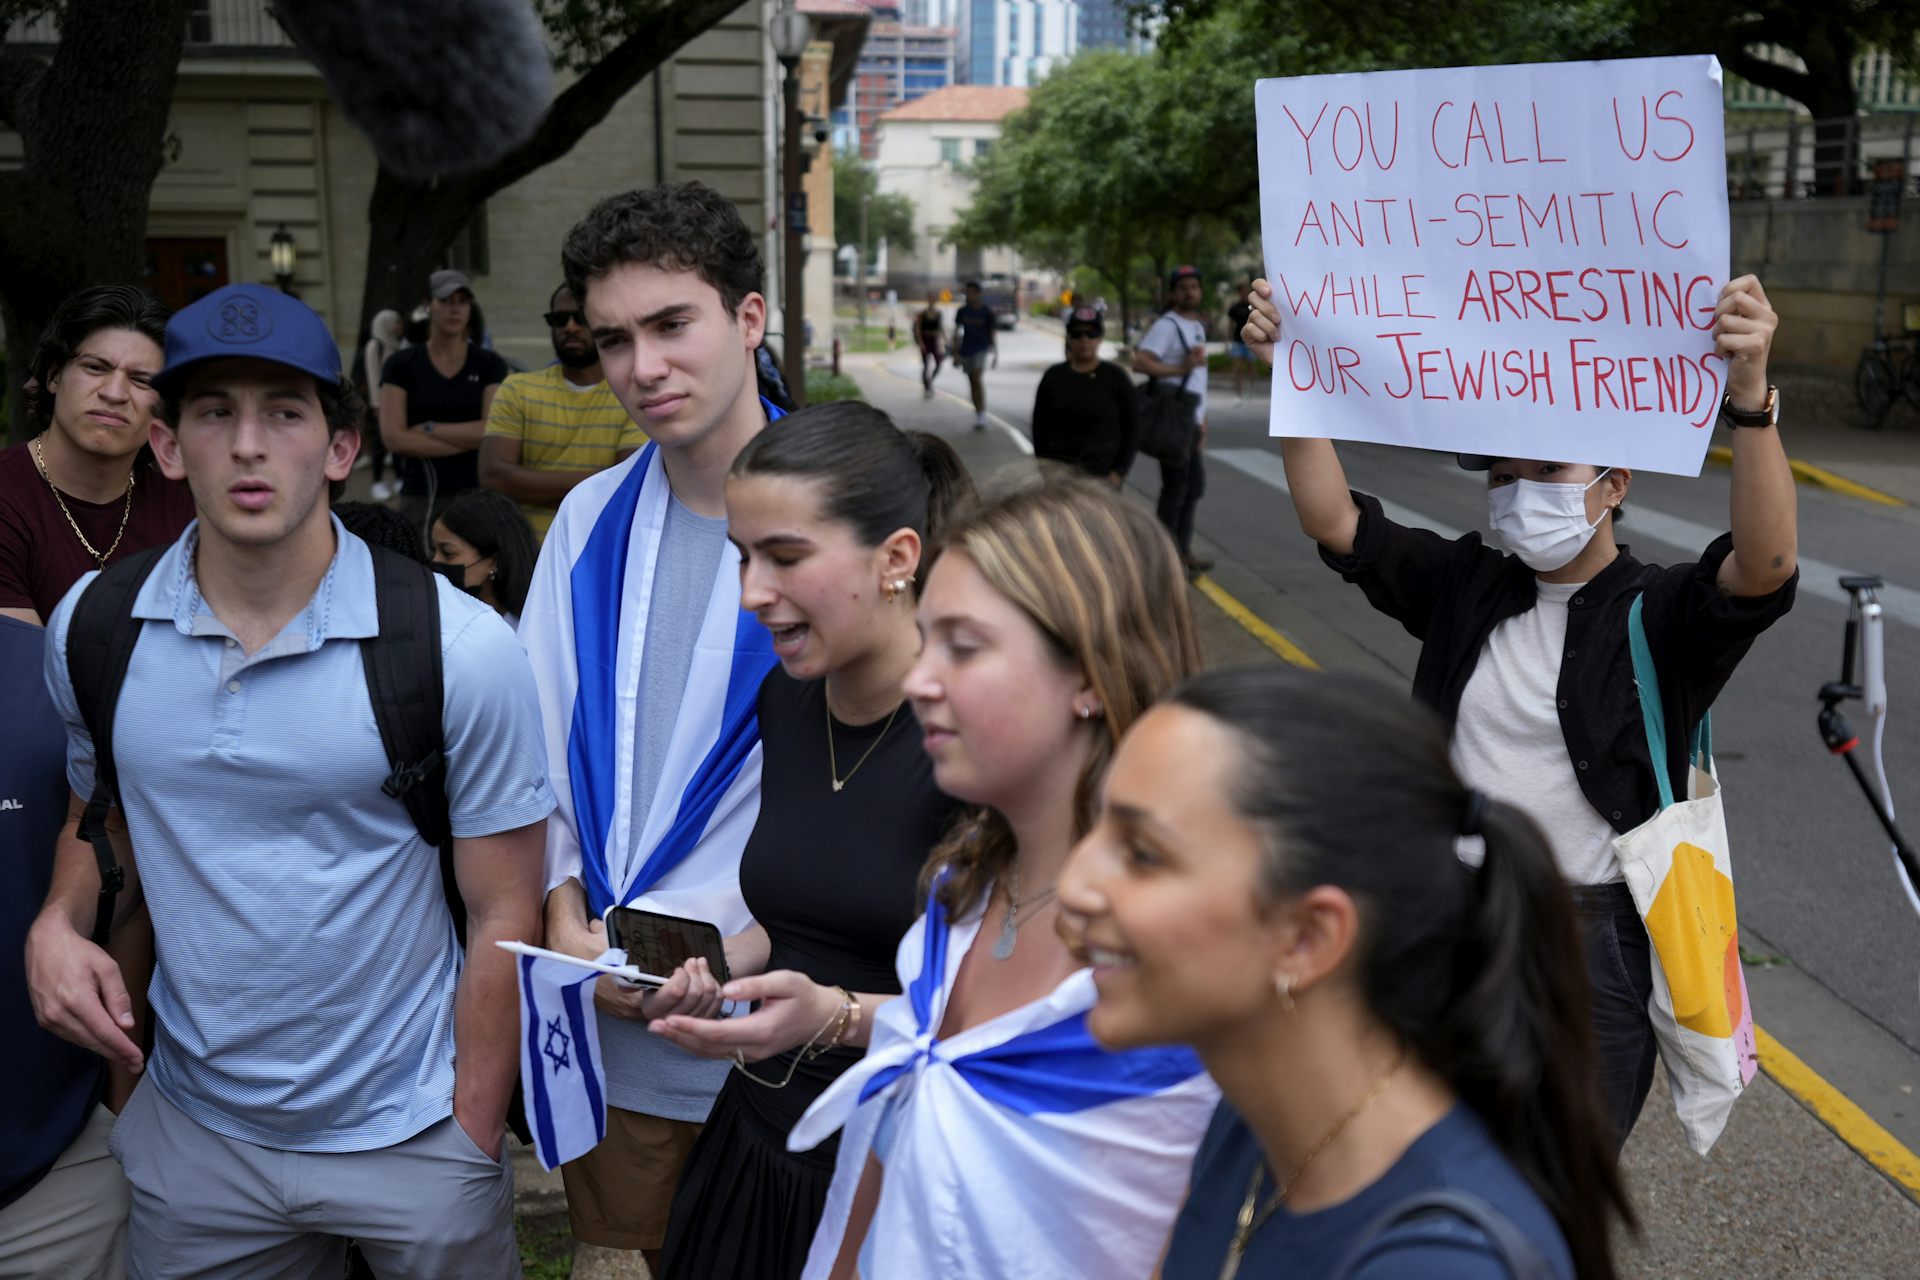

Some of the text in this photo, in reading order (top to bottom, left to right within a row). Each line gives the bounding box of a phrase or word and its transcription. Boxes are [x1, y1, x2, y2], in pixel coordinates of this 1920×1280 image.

[1282, 90, 1695, 175] YOU CALL US
[1294, 190, 1690, 249] ANTI-SEMITIC
[1280, 267, 1718, 331] WHILE ARRESTING
[1287, 331, 1724, 429] OUR JEWISH FRIENDS
[0, 798, 24, 810] AL
